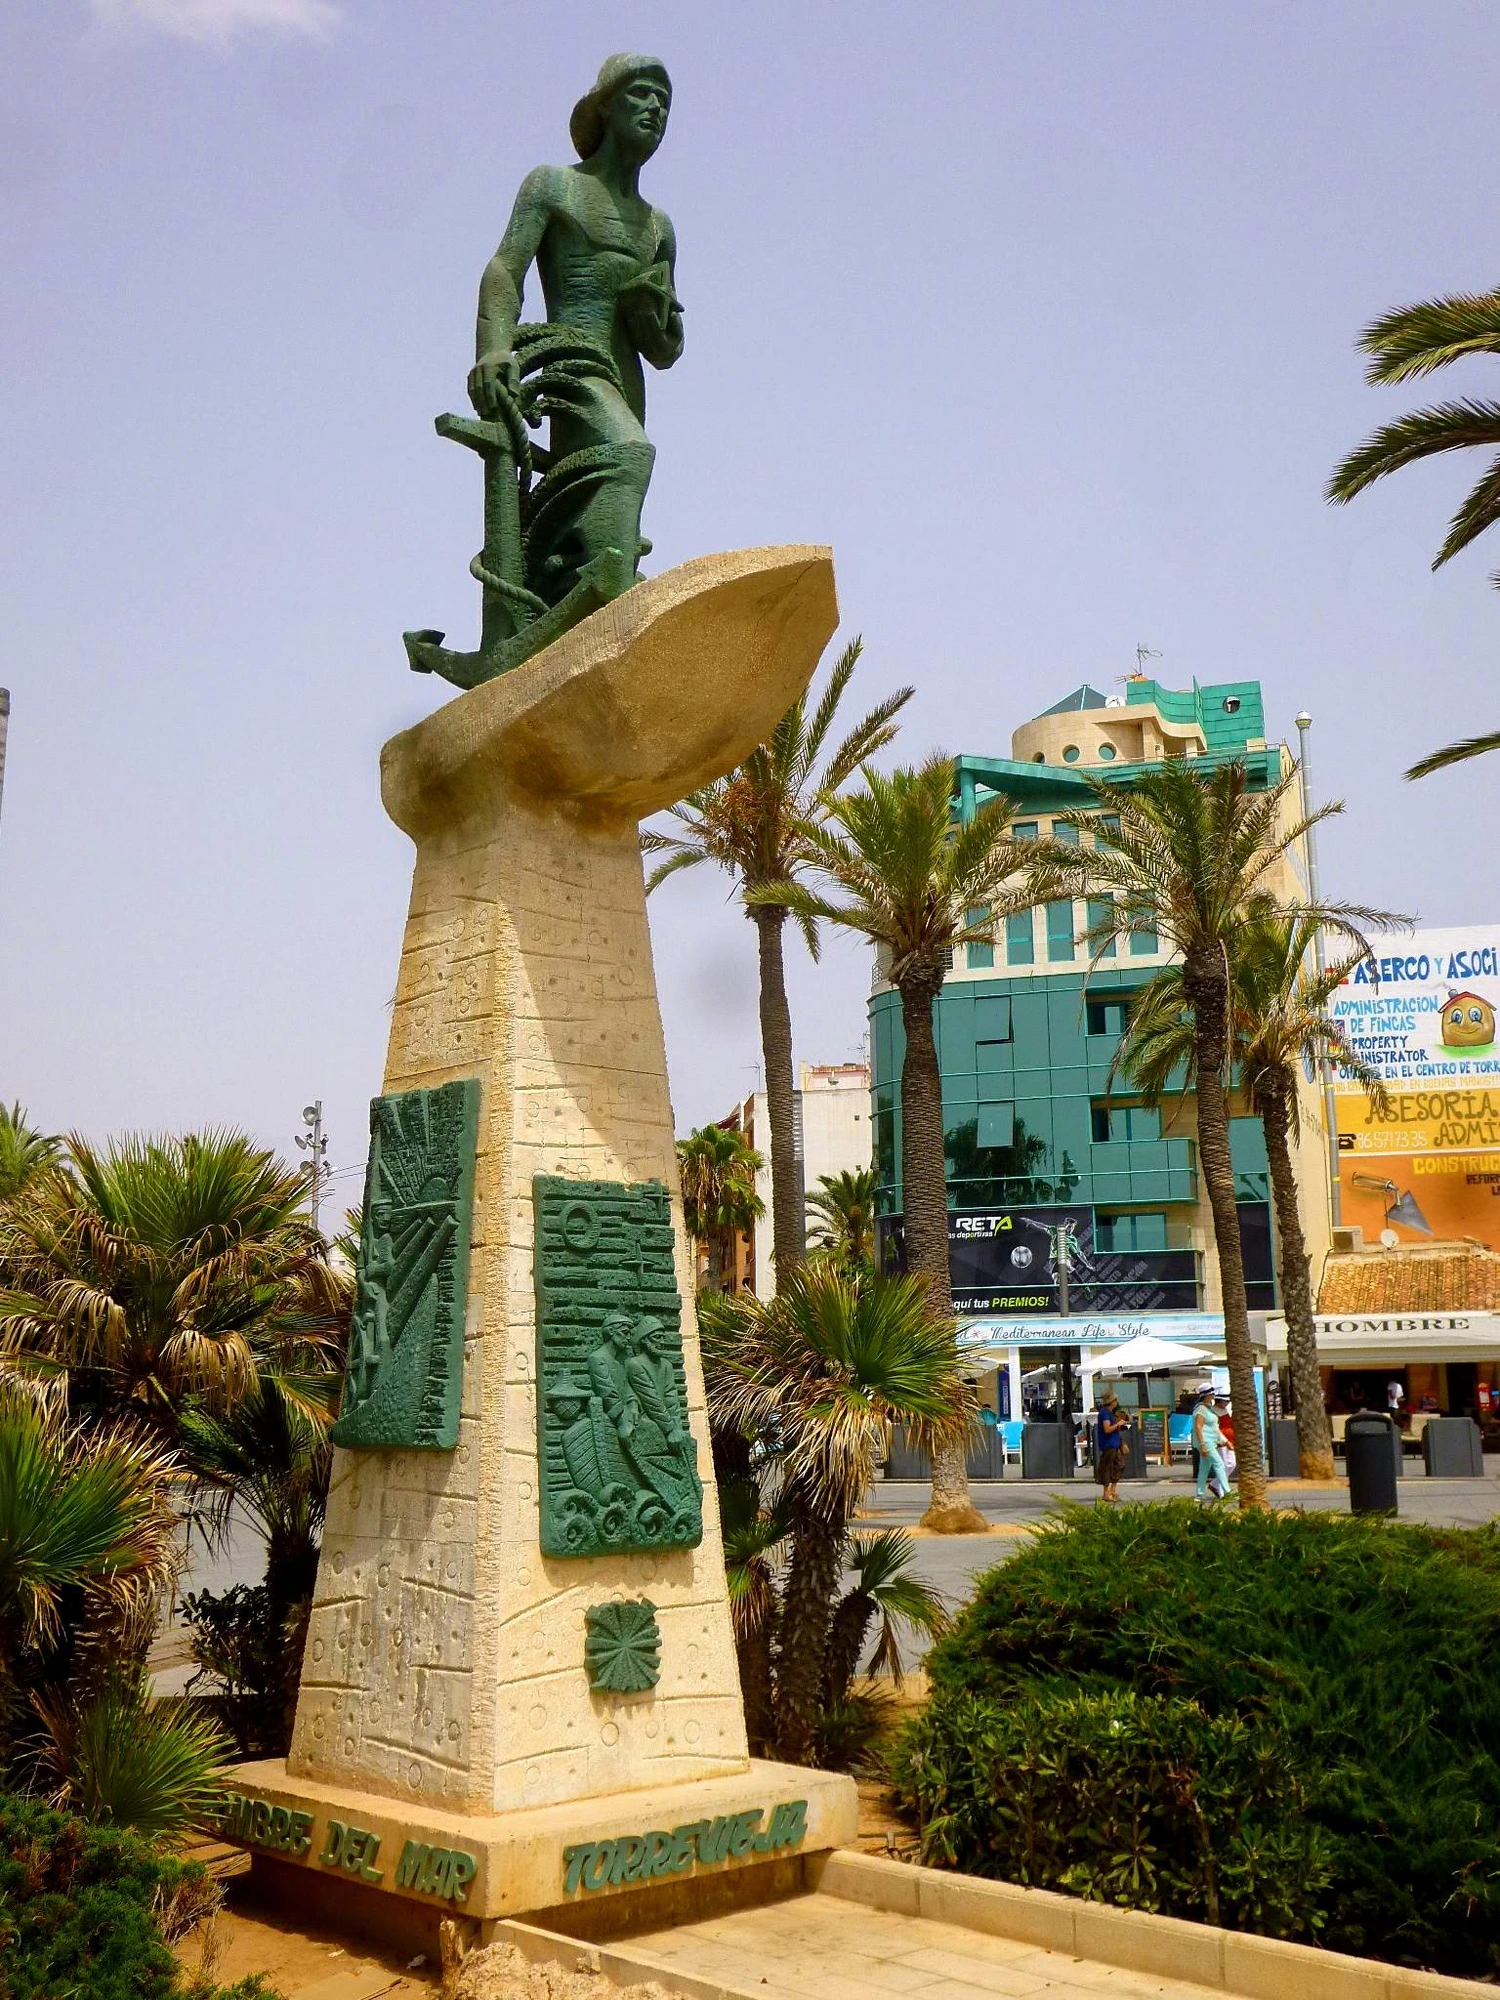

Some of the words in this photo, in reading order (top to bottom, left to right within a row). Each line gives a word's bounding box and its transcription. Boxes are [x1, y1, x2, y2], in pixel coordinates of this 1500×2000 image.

[1354, 954, 1430, 984] ASERCO
[1434, 957, 1443, 975] Y
[1333, 995, 1439, 1016] ADMINISTRACION
[1350, 1016, 1364, 1033] DE
[1370, 1014, 1416, 1032] FINCAS
[1351, 1035, 1408, 1050] PROPERTY
[1356, 1048, 1429, 1065] INISTRATOR
[1386, 1066, 1398, 1079] EN
[1402, 1065, 1413, 1078] EL
[1416, 1062, 1457, 1076] CENTRO
[1460, 1061, 1471, 1074] DE
[1434, 1117, 1500, 1147] ADMI
[952, 1298, 973, 1312] quí
[974, 1298, 990, 1308] tus
[991, 1296, 1050, 1309] PREMIOS!
[990, 1325, 1076, 1340] Mediterranean
[1081, 1323, 1106, 1340] Life
[1118, 1322, 1151, 1338] Style
[1312, 1317, 1470, 1334] HOMBRE
[220, 1793, 315, 1857] MBRE
[318, 1819, 385, 1883] DEL
[394, 1838, 478, 1902] MAR
[563, 1799, 809, 1894] TORREVIEJA
